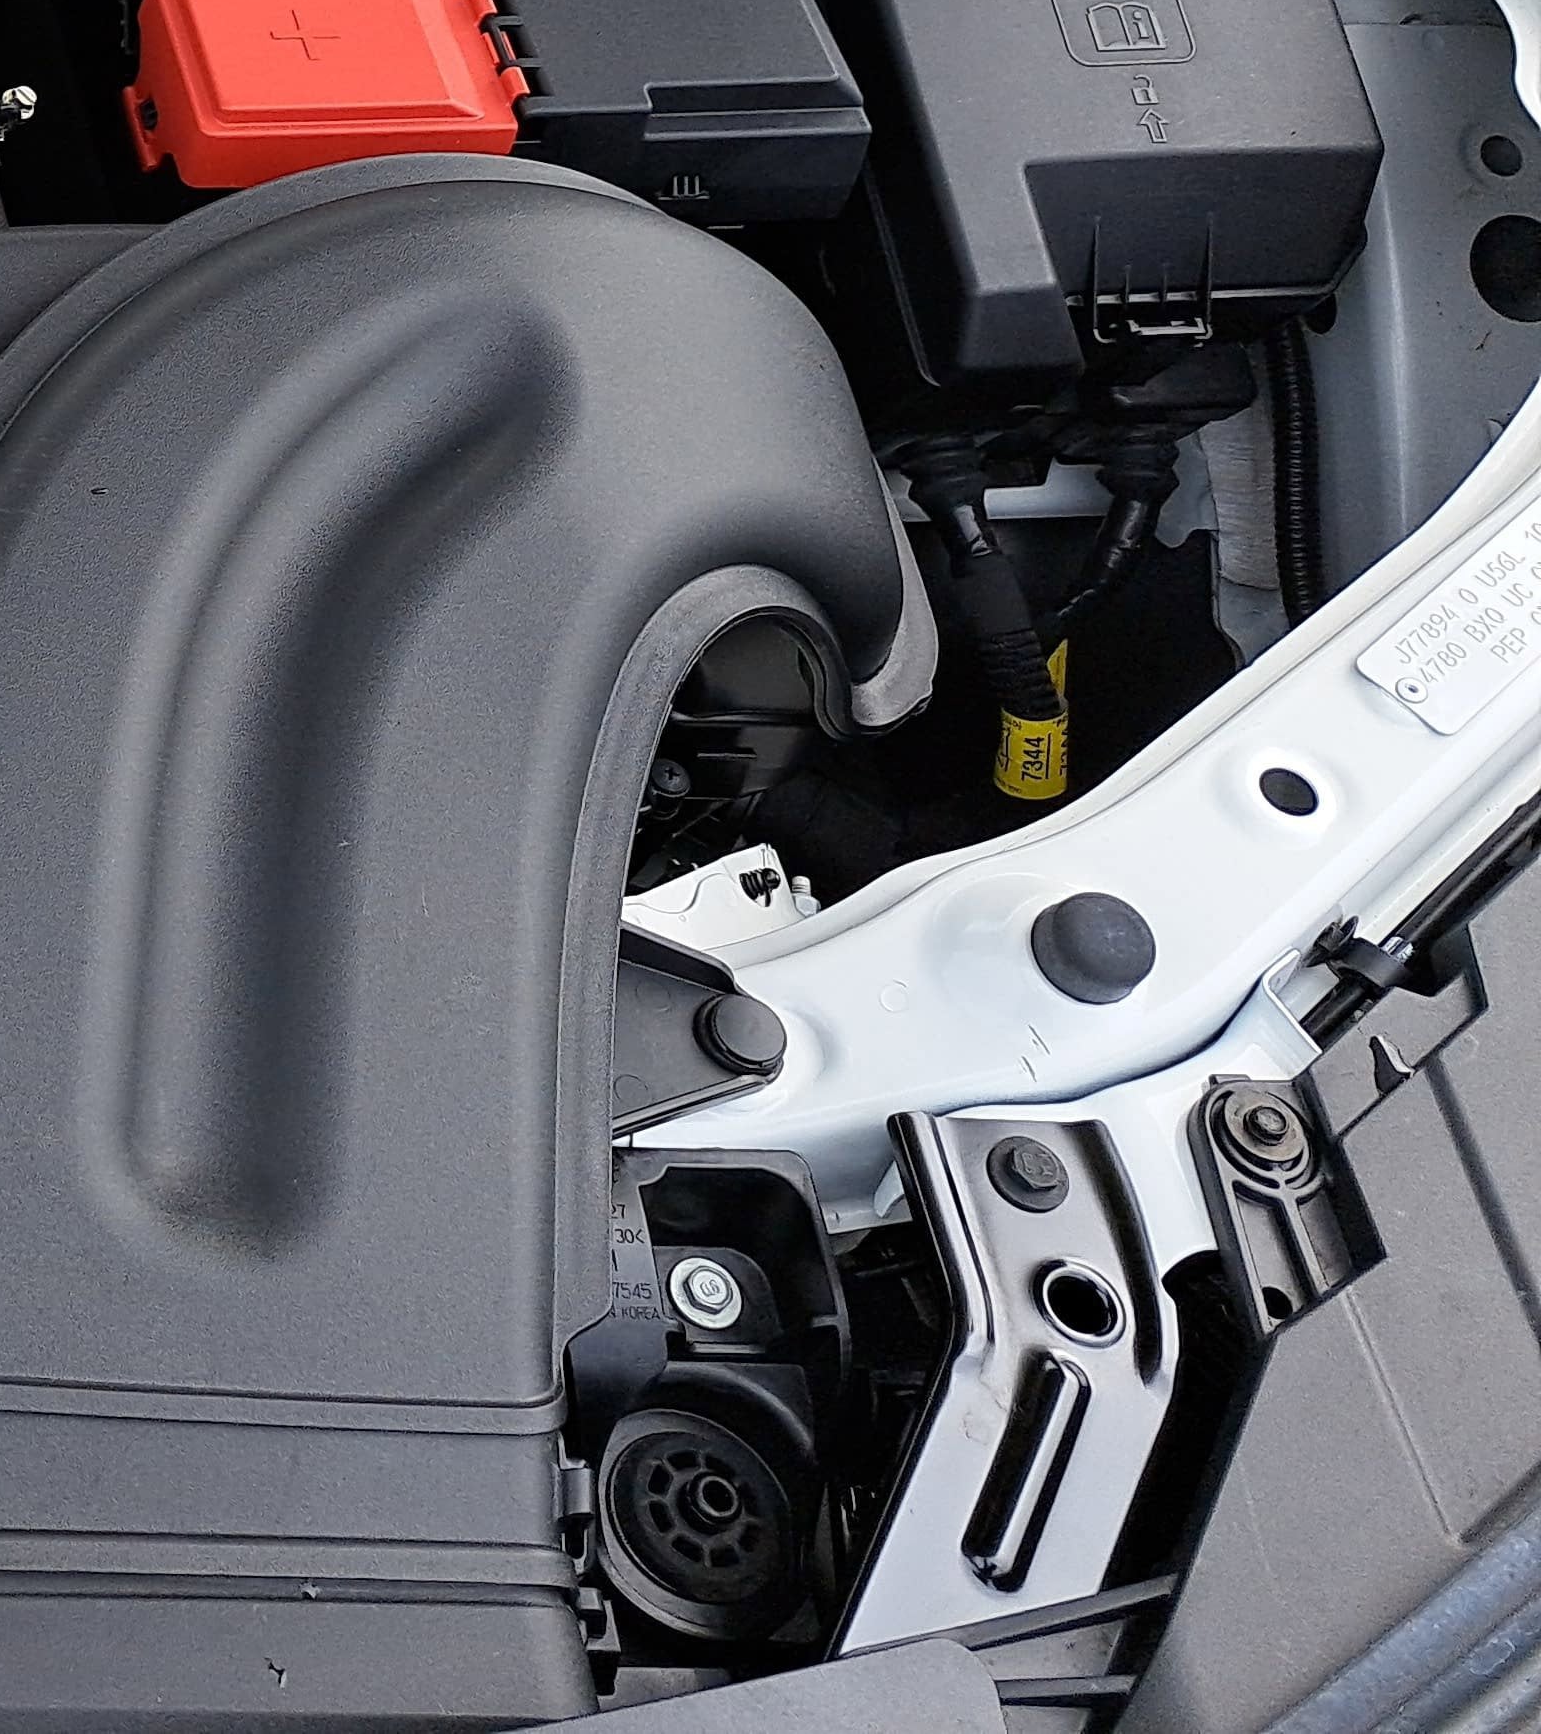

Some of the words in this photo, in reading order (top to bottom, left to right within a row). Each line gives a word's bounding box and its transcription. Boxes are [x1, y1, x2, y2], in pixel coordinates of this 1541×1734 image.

[1501, 583, 1534, 607] UC
[1490, 627, 1528, 663] PEP
[1021, 737, 1044, 782] 7344
[622, 1307, 660, 1320] KOREA
